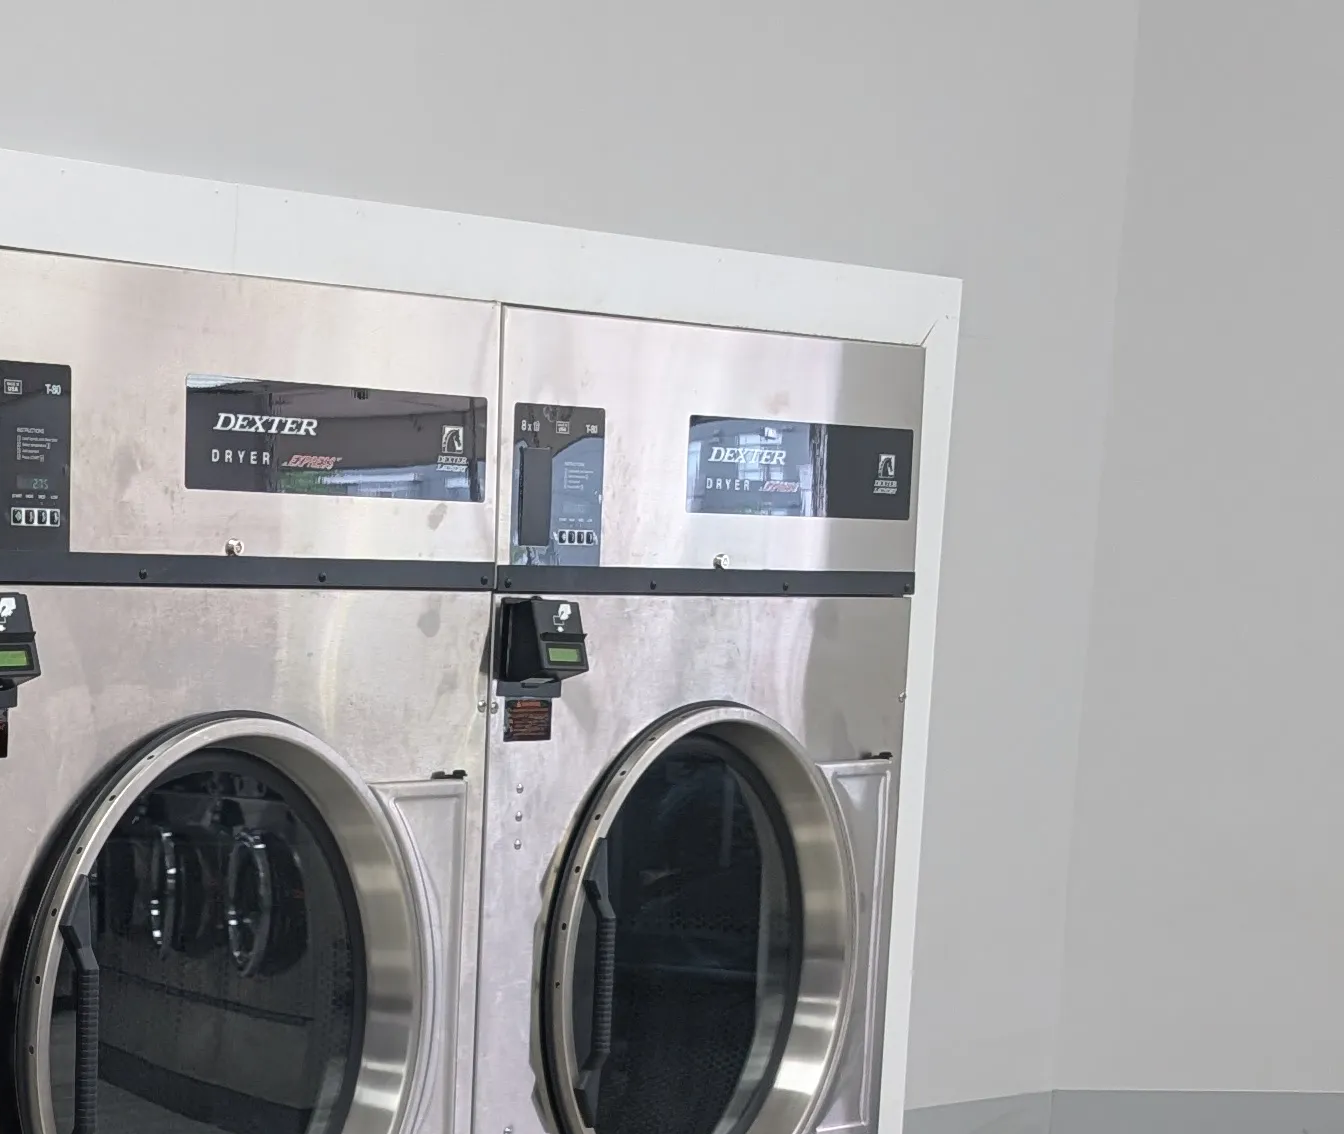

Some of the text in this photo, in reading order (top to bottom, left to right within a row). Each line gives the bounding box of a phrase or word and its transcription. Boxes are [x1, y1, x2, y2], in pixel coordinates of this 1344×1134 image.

[44, 384, 62, 396] T-80
[212, 412, 318, 436] DEXTER
[212, 448, 336, 470] DRYER EXPRESS
[708, 446, 786, 466] DEXTER
[706, 477, 750, 491] DRYER
